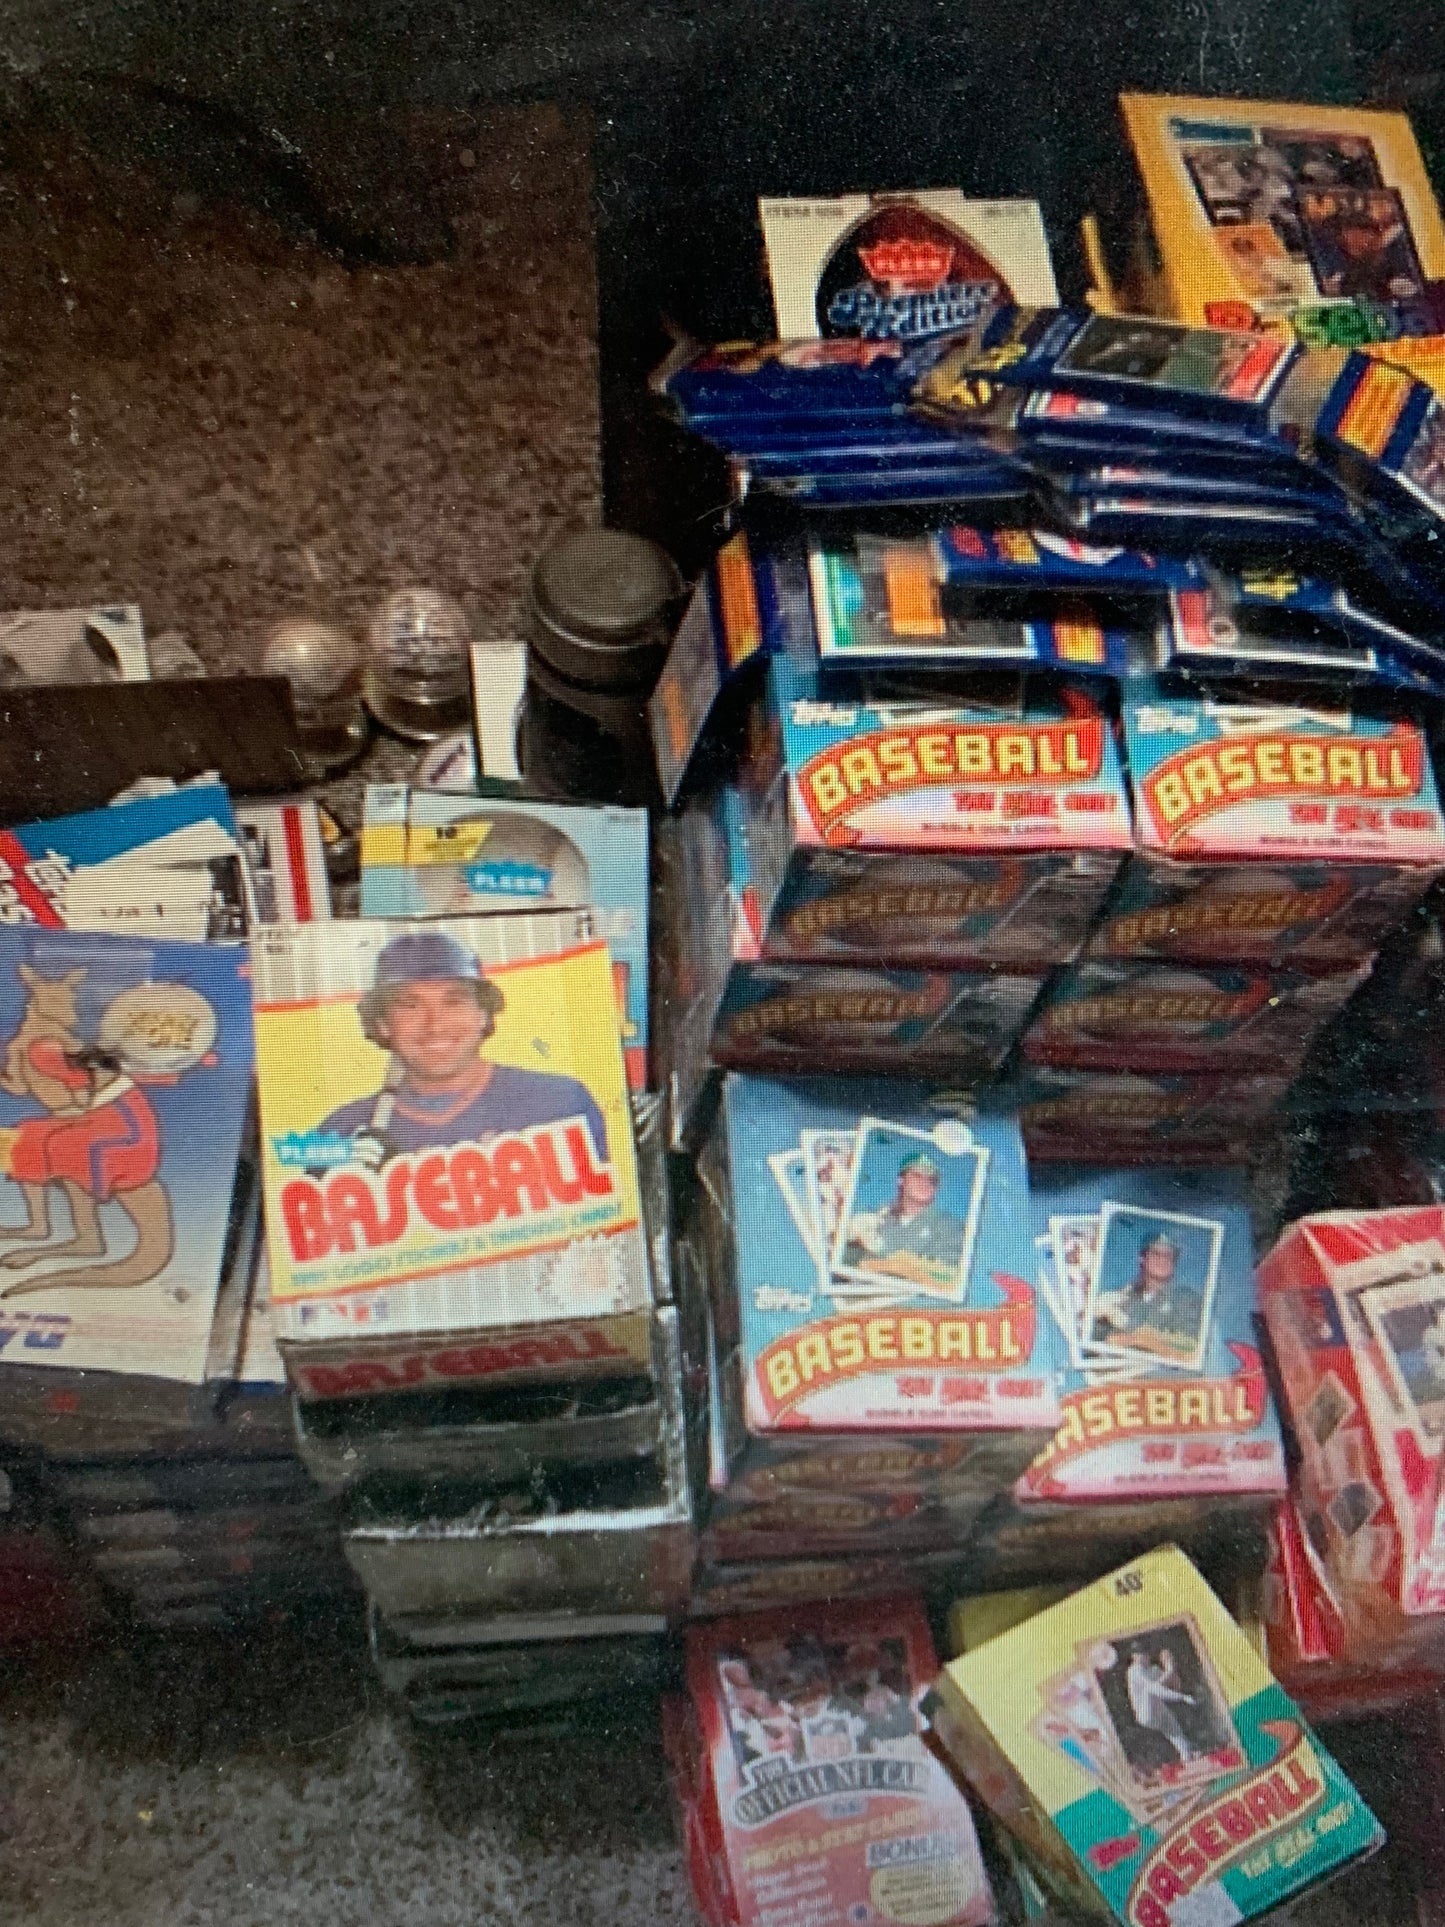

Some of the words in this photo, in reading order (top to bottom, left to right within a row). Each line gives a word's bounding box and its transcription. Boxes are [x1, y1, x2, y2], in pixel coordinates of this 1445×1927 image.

[810, 734, 1089, 813] BASEBALL
[1153, 742, 1412, 823] BASEBALL
[282, 1127, 613, 1263] BASEBALL
[766, 1318, 1020, 1400] BASEBALL
[736, 1764, 829, 1824] OFFICIAL
[1135, 1758, 1321, 1926] BASEBALL
